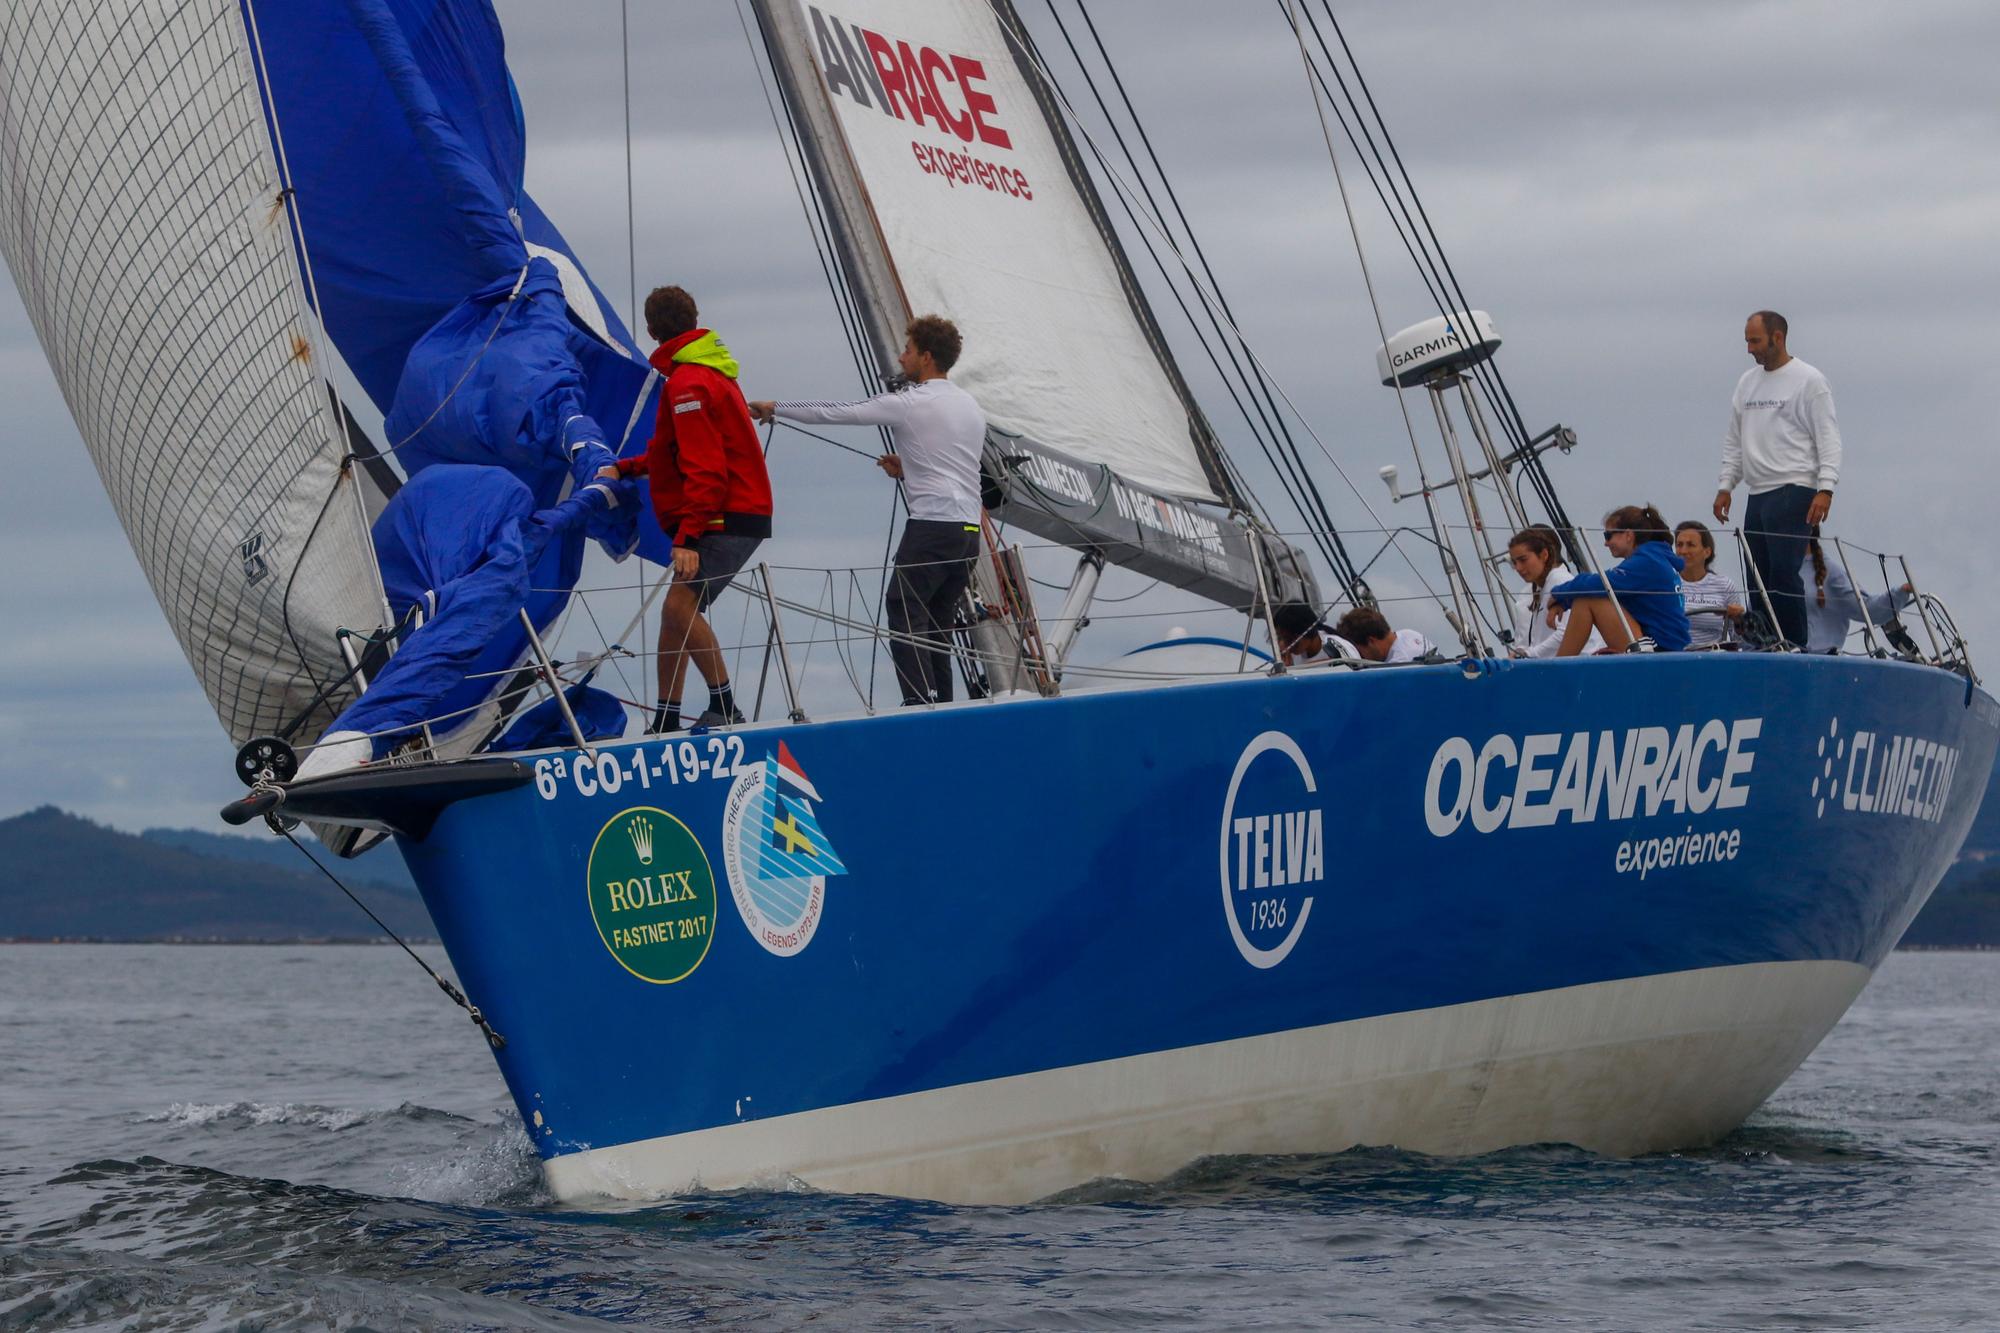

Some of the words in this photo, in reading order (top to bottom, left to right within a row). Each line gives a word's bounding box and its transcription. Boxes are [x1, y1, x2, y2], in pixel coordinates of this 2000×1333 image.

[911, 140, 1033, 201] experience
[1393, 334, 1460, 367] GARMIN
[1111, 482, 1163, 532] MAGIC
[573, 735, 748, 797] CO-1-19-22
[735, 770, 760, 802] HAGUE
[1424, 717, 1763, 837] OCEANRACE
[1233, 808, 1324, 891] TELVA
[1615, 828, 1741, 880] experience
[606, 870, 697, 912] ROLEX
[762, 927, 798, 948] LEGENDS
[797, 885, 821, 940] 1973-2018
[1251, 897, 1287, 931] 1936
[613, 921, 675, 949] FASTNET
[679, 915, 707, 940] 2017
